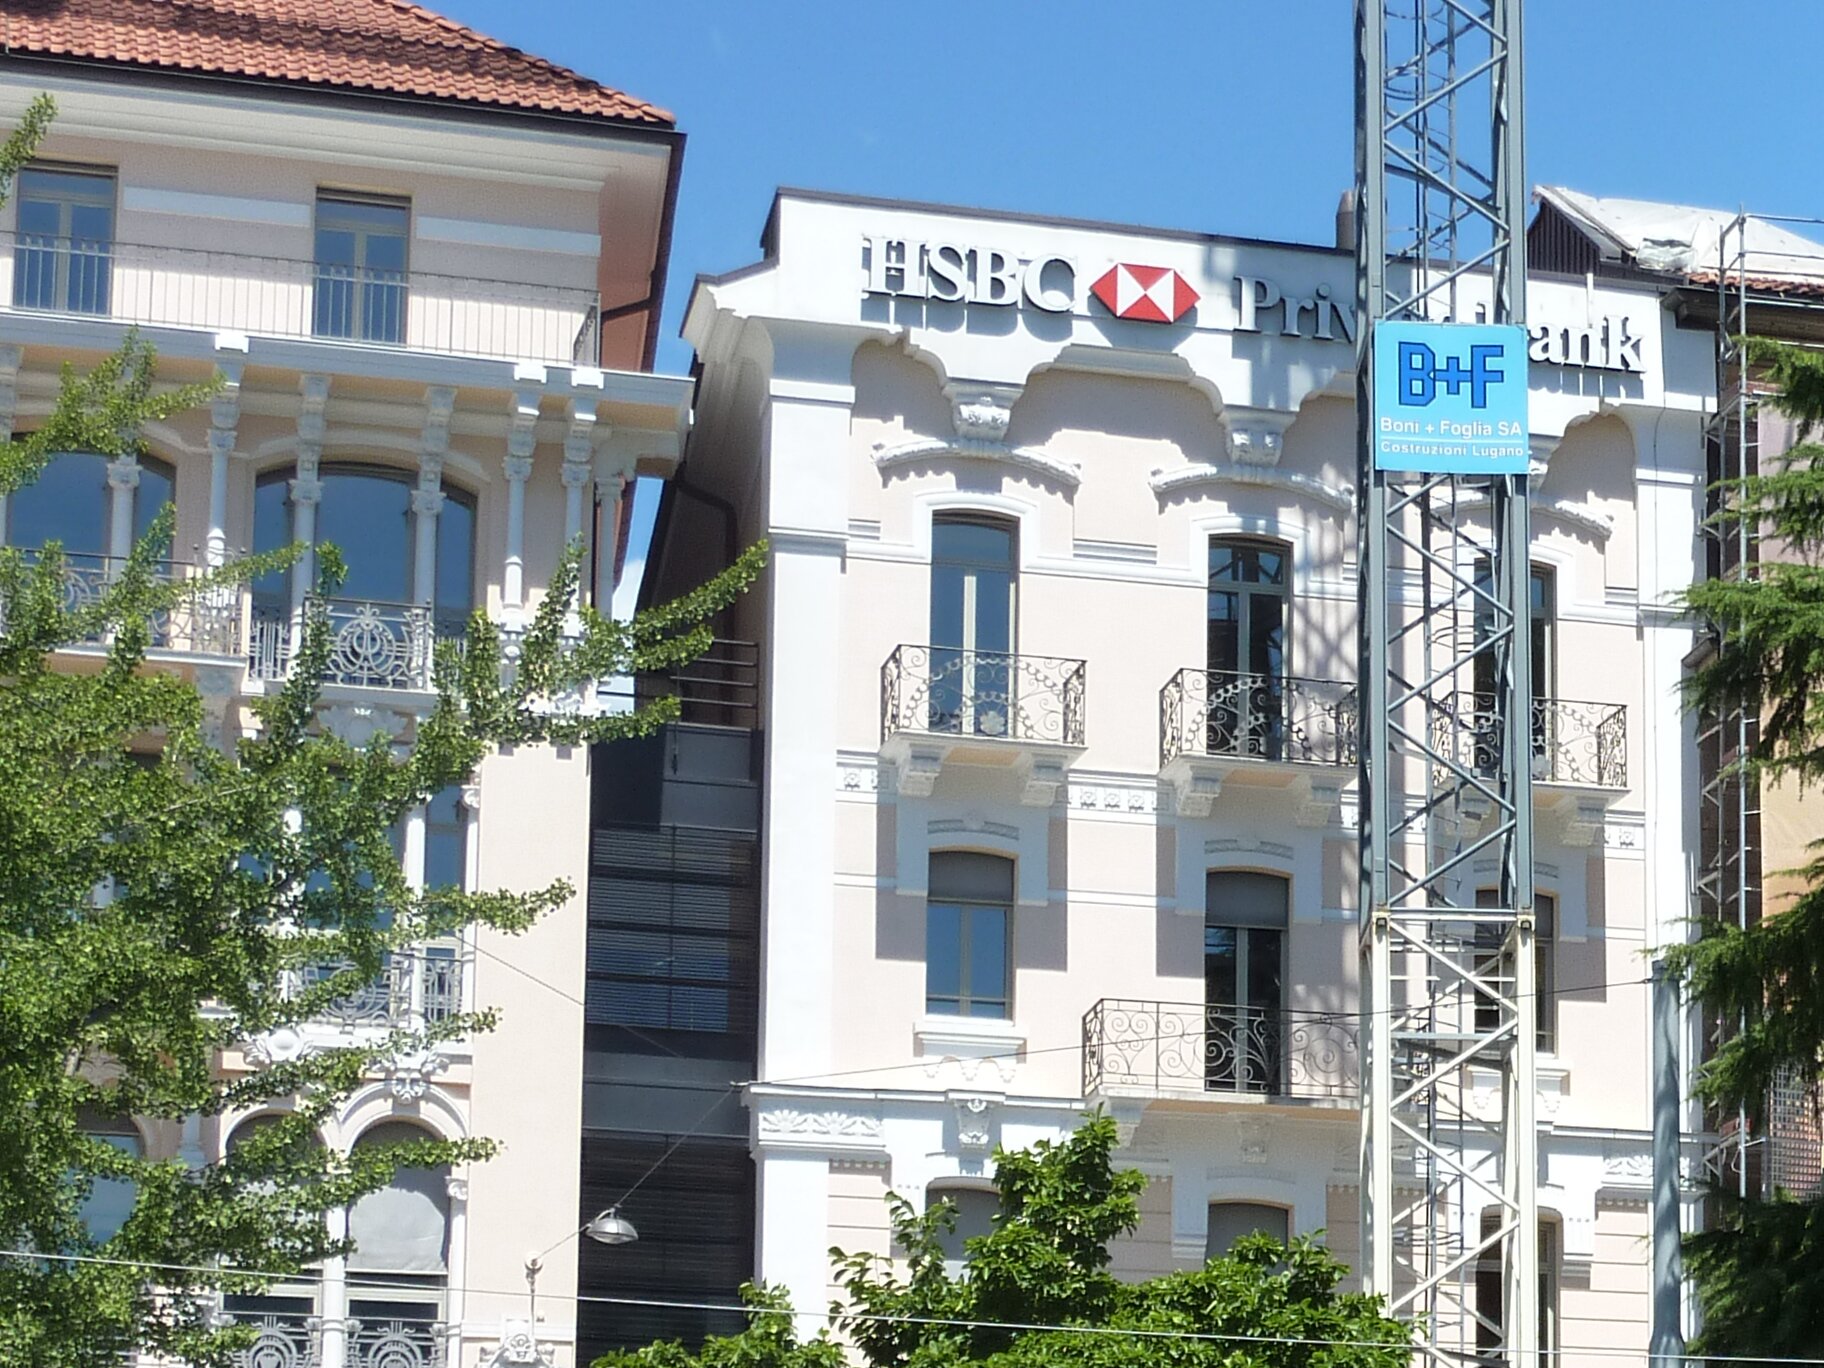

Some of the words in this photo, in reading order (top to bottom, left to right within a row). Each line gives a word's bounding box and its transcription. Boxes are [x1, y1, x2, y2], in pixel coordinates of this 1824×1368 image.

[862, 235, 1077, 312] HSBC
[1527, 314, 1647, 373] ank
[1398, 341, 1504, 409] B+F
[1380, 418, 1419, 434] Boni
[1425, 425, 1435, 434] +
[1440, 420, 1492, 439] Foglia
[1498, 421, 1522, 435] SA
[1381, 441, 1467, 457] Costruzioni
[1472, 446, 1524, 459] Lugano
